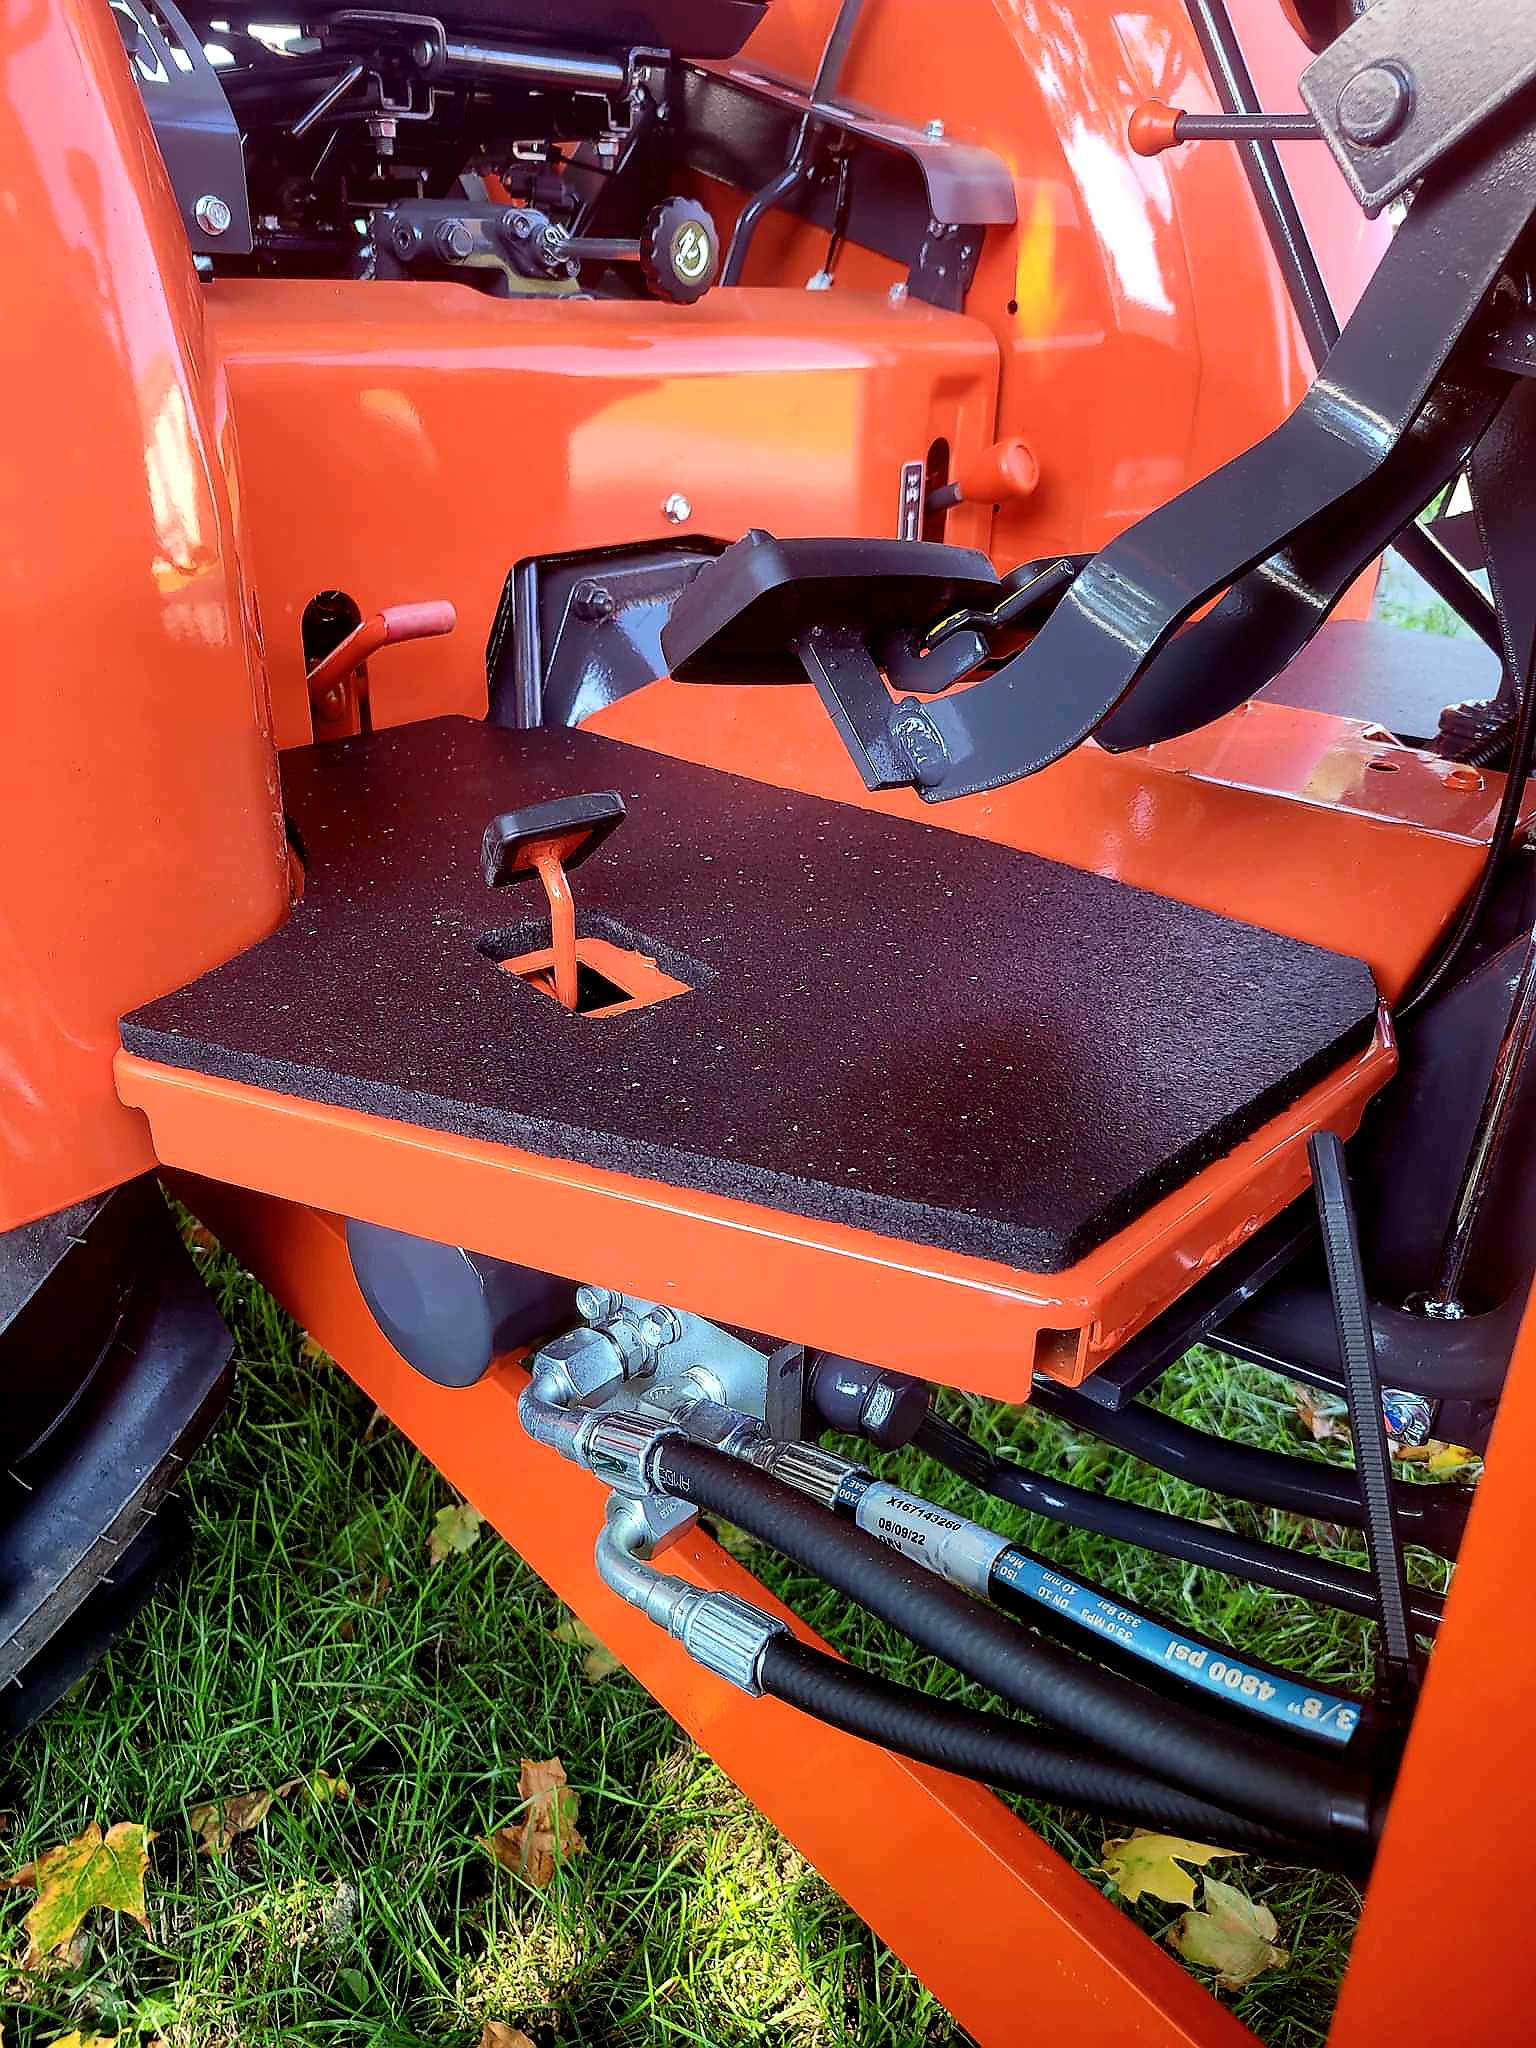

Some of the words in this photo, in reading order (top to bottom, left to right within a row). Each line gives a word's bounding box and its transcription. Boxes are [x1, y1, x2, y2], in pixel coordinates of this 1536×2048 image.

[886, 1496, 962, 1531] X167143260
[878, 1517, 926, 1546] 08/09/22
[999, 1565, 1019, 1583] ISO
[1042, 1571, 1063, 1587] mm
[1037, 1585, 1054, 1600] 10
[1062, 1580, 1080, 1596] 10
[1053, 1593, 1071, 1610] DN
[1096, 1599, 1118, 1617] Bar
[1080, 1608, 1107, 1627] MPa
[1117, 1611, 1142, 1629] 330
[1106, 1621, 1134, 1643] 33.0
[1164, 1640, 1209, 1669] psi
[1208, 1661, 1277, 1701] 4800
